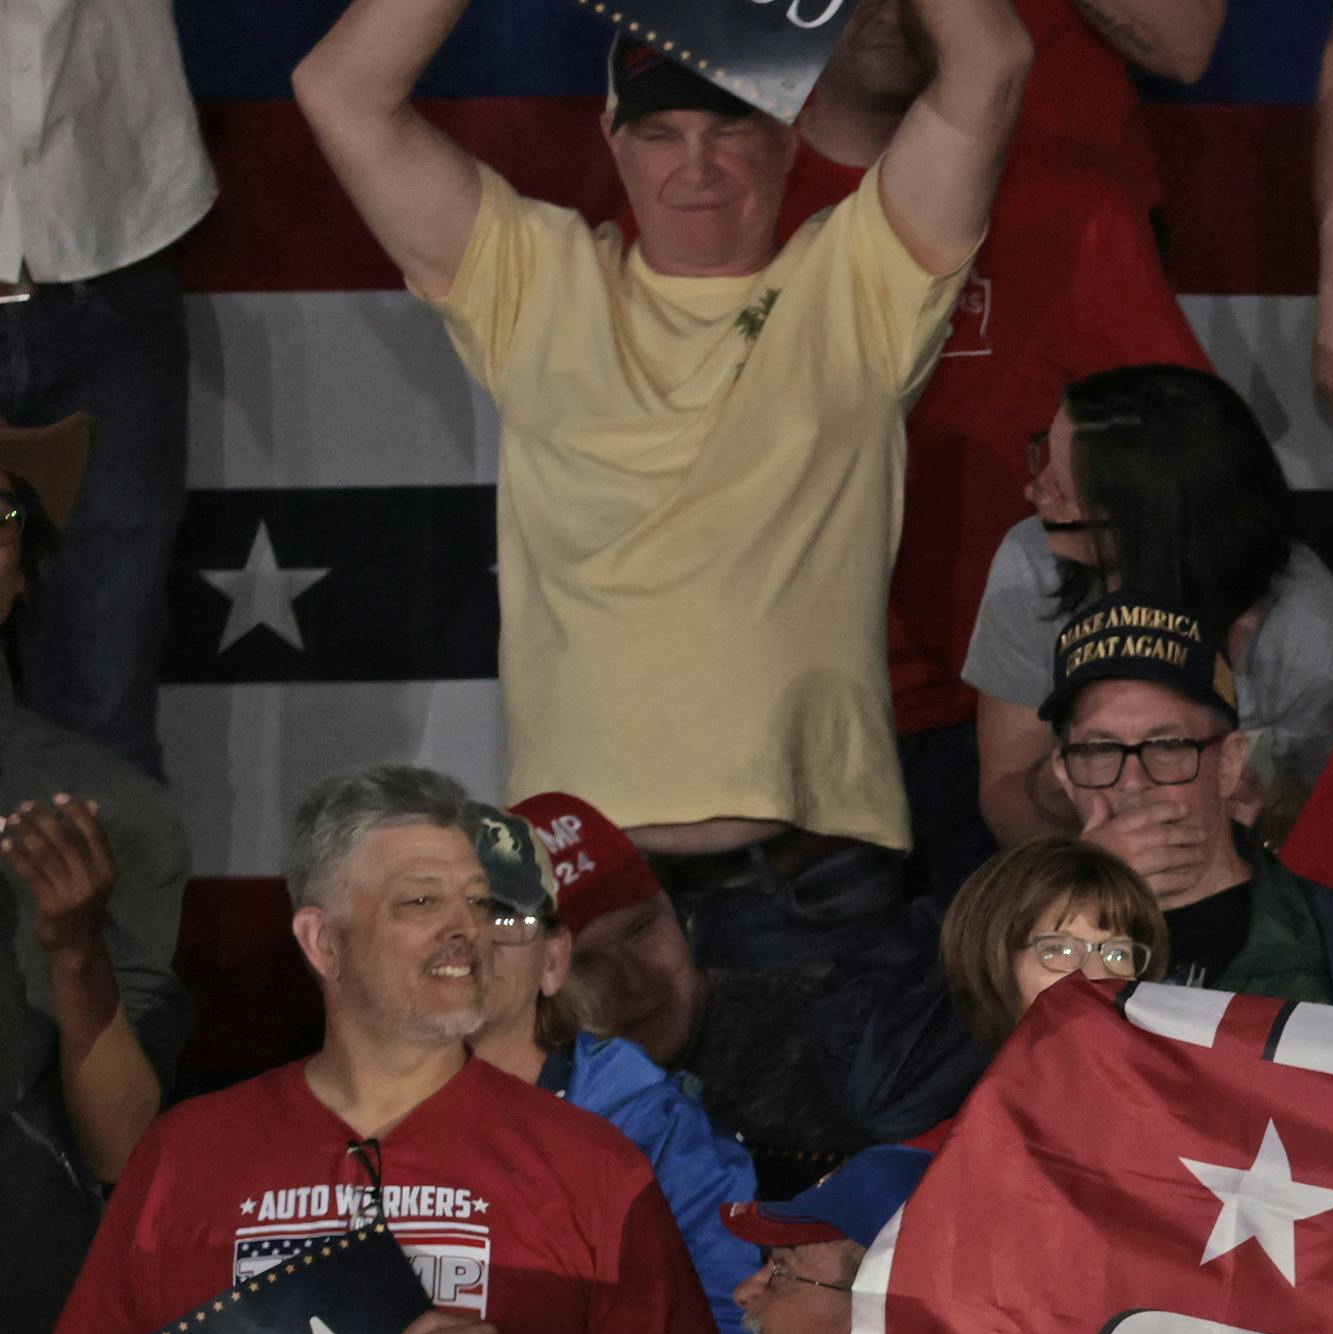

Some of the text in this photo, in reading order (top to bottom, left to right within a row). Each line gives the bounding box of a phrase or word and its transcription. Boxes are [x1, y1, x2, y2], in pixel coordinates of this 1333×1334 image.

[1105, 605, 1201, 642] AMERICA
[1121, 635, 1188, 669] AGAIN
[257, 1184, 331, 1222] AUTO
